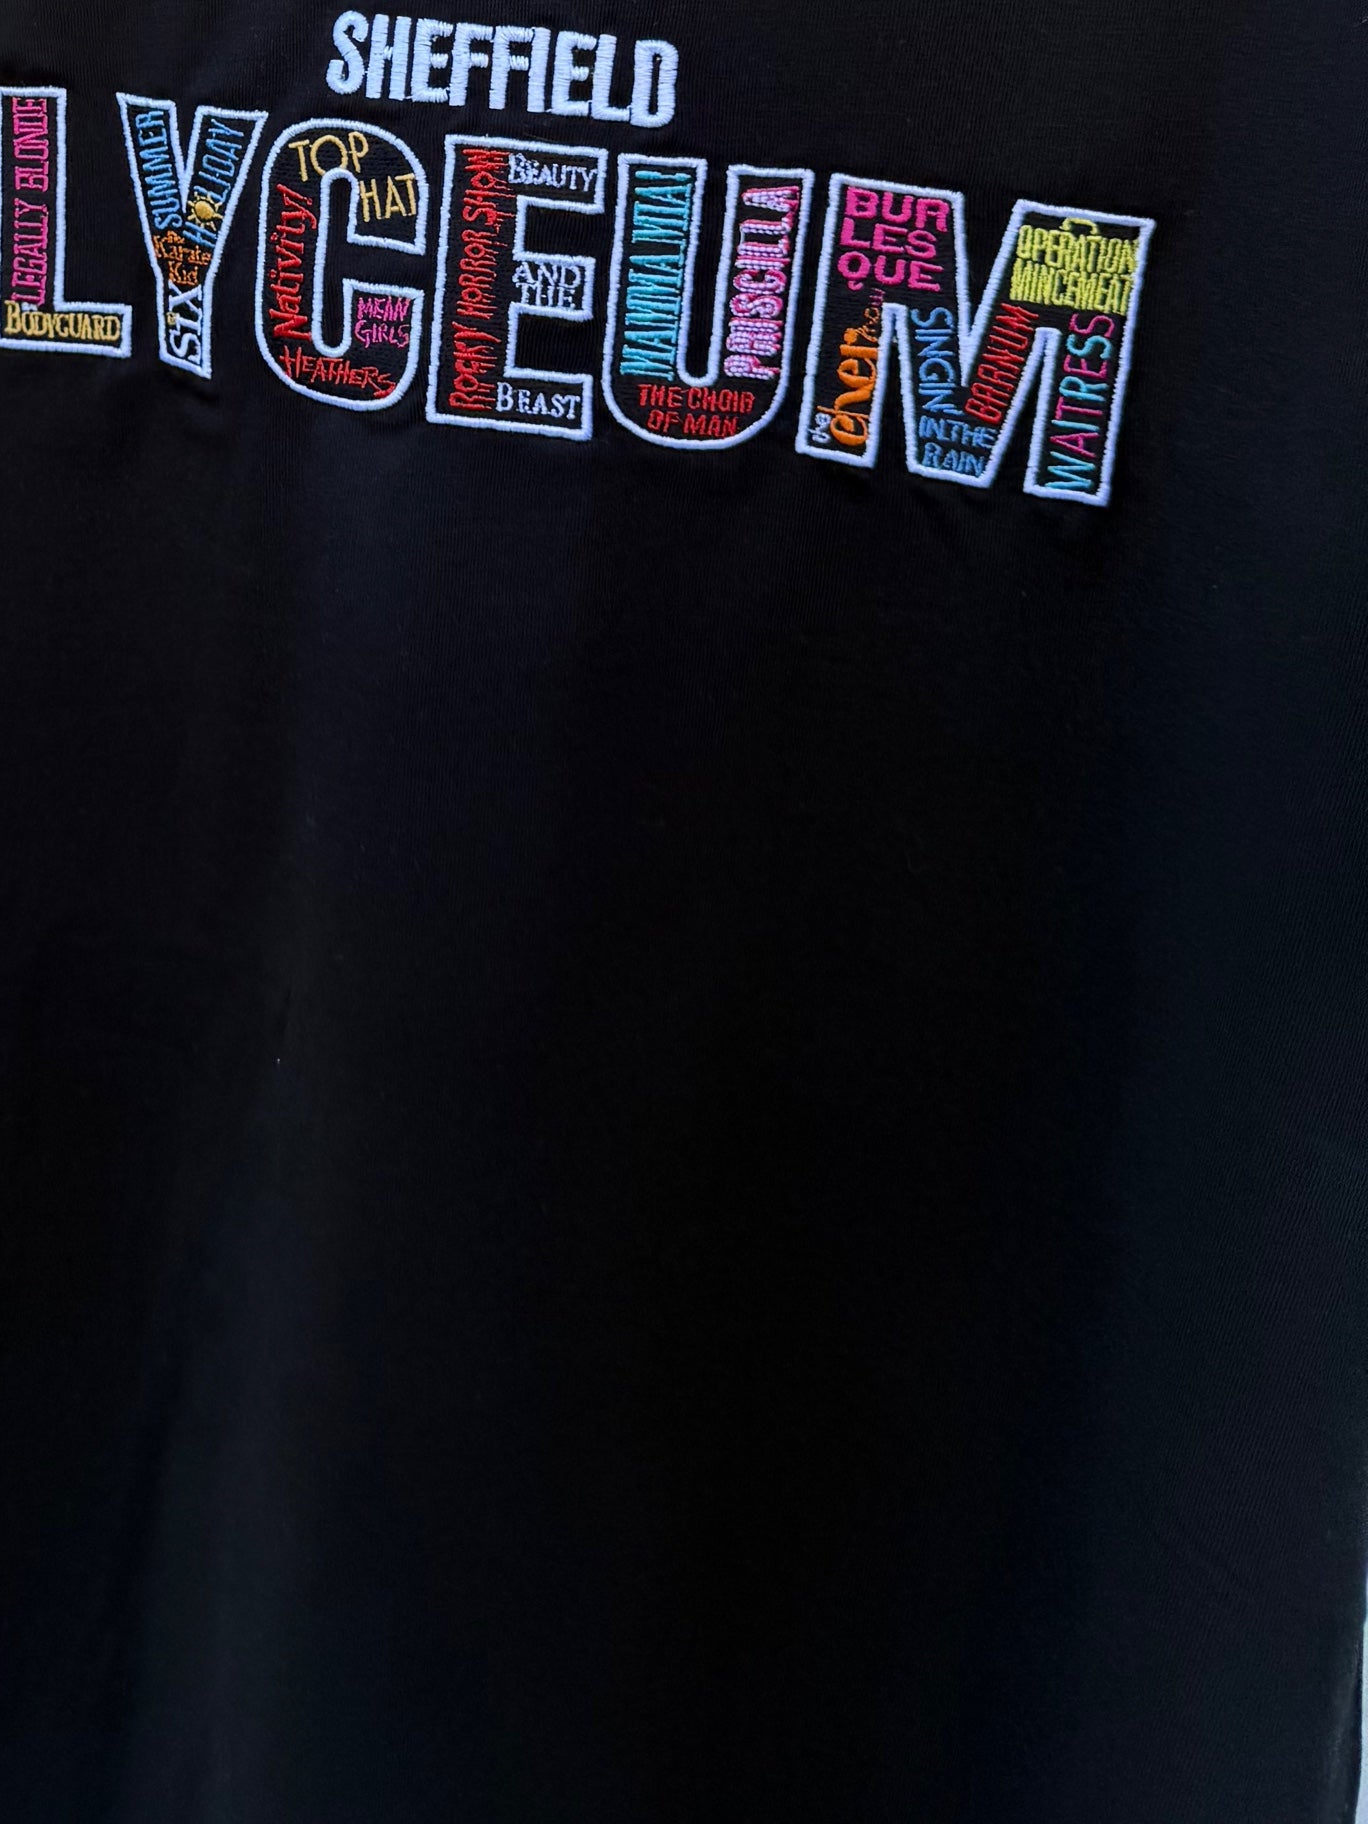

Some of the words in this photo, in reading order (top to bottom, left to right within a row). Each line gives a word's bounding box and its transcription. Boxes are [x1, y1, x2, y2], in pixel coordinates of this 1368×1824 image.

[326, 10, 679, 128] SHEFFIELD
[12, 97, 49, 192] BLONDE
[135, 110, 183, 229] SUMMER
[288, 131, 369, 182] TOP
[359, 173, 417, 222] HAT
[462, 149, 516, 229] SHOW
[508, 153, 598, 192] BEAUTY
[631, 170, 693, 247] MIA!
[844, 186, 950, 232] BUR
[12, 198, 48, 306] LEGALLY
[152, 235, 211, 265] Karate
[268, 183, 317, 341] Nativity!
[839, 217, 937, 259] LES
[1016, 224, 1139, 274] OPERATION
[167, 261, 198, 285] Kid
[456, 229, 507, 319] HORROR
[512, 260, 581, 288] AND
[515, 282, 577, 309] THE
[723, 186, 800, 381] PRISCILLA
[837, 251, 944, 292] QUE
[1009, 257, 1134, 316] MINCEMEAT
[4, 300, 121, 340] BODYGUARD
[357, 296, 410, 321] MEAN
[620, 255, 684, 382] MAMMA
[355, 320, 410, 348] GIRLS
[279, 345, 395, 398] HEATHERS
[449, 321, 501, 411] ROCKY
[964, 302, 1040, 425] BARNUM
[496, 381, 581, 419] BEAST
[637, 384, 682, 407] THE
[687, 388, 756, 414] CHOIR
[647, 410, 681, 433] OF
[684, 413, 738, 438] MAN
[1044, 313, 1115, 491] WAITRESS
[922, 441, 986, 478] RAIN
